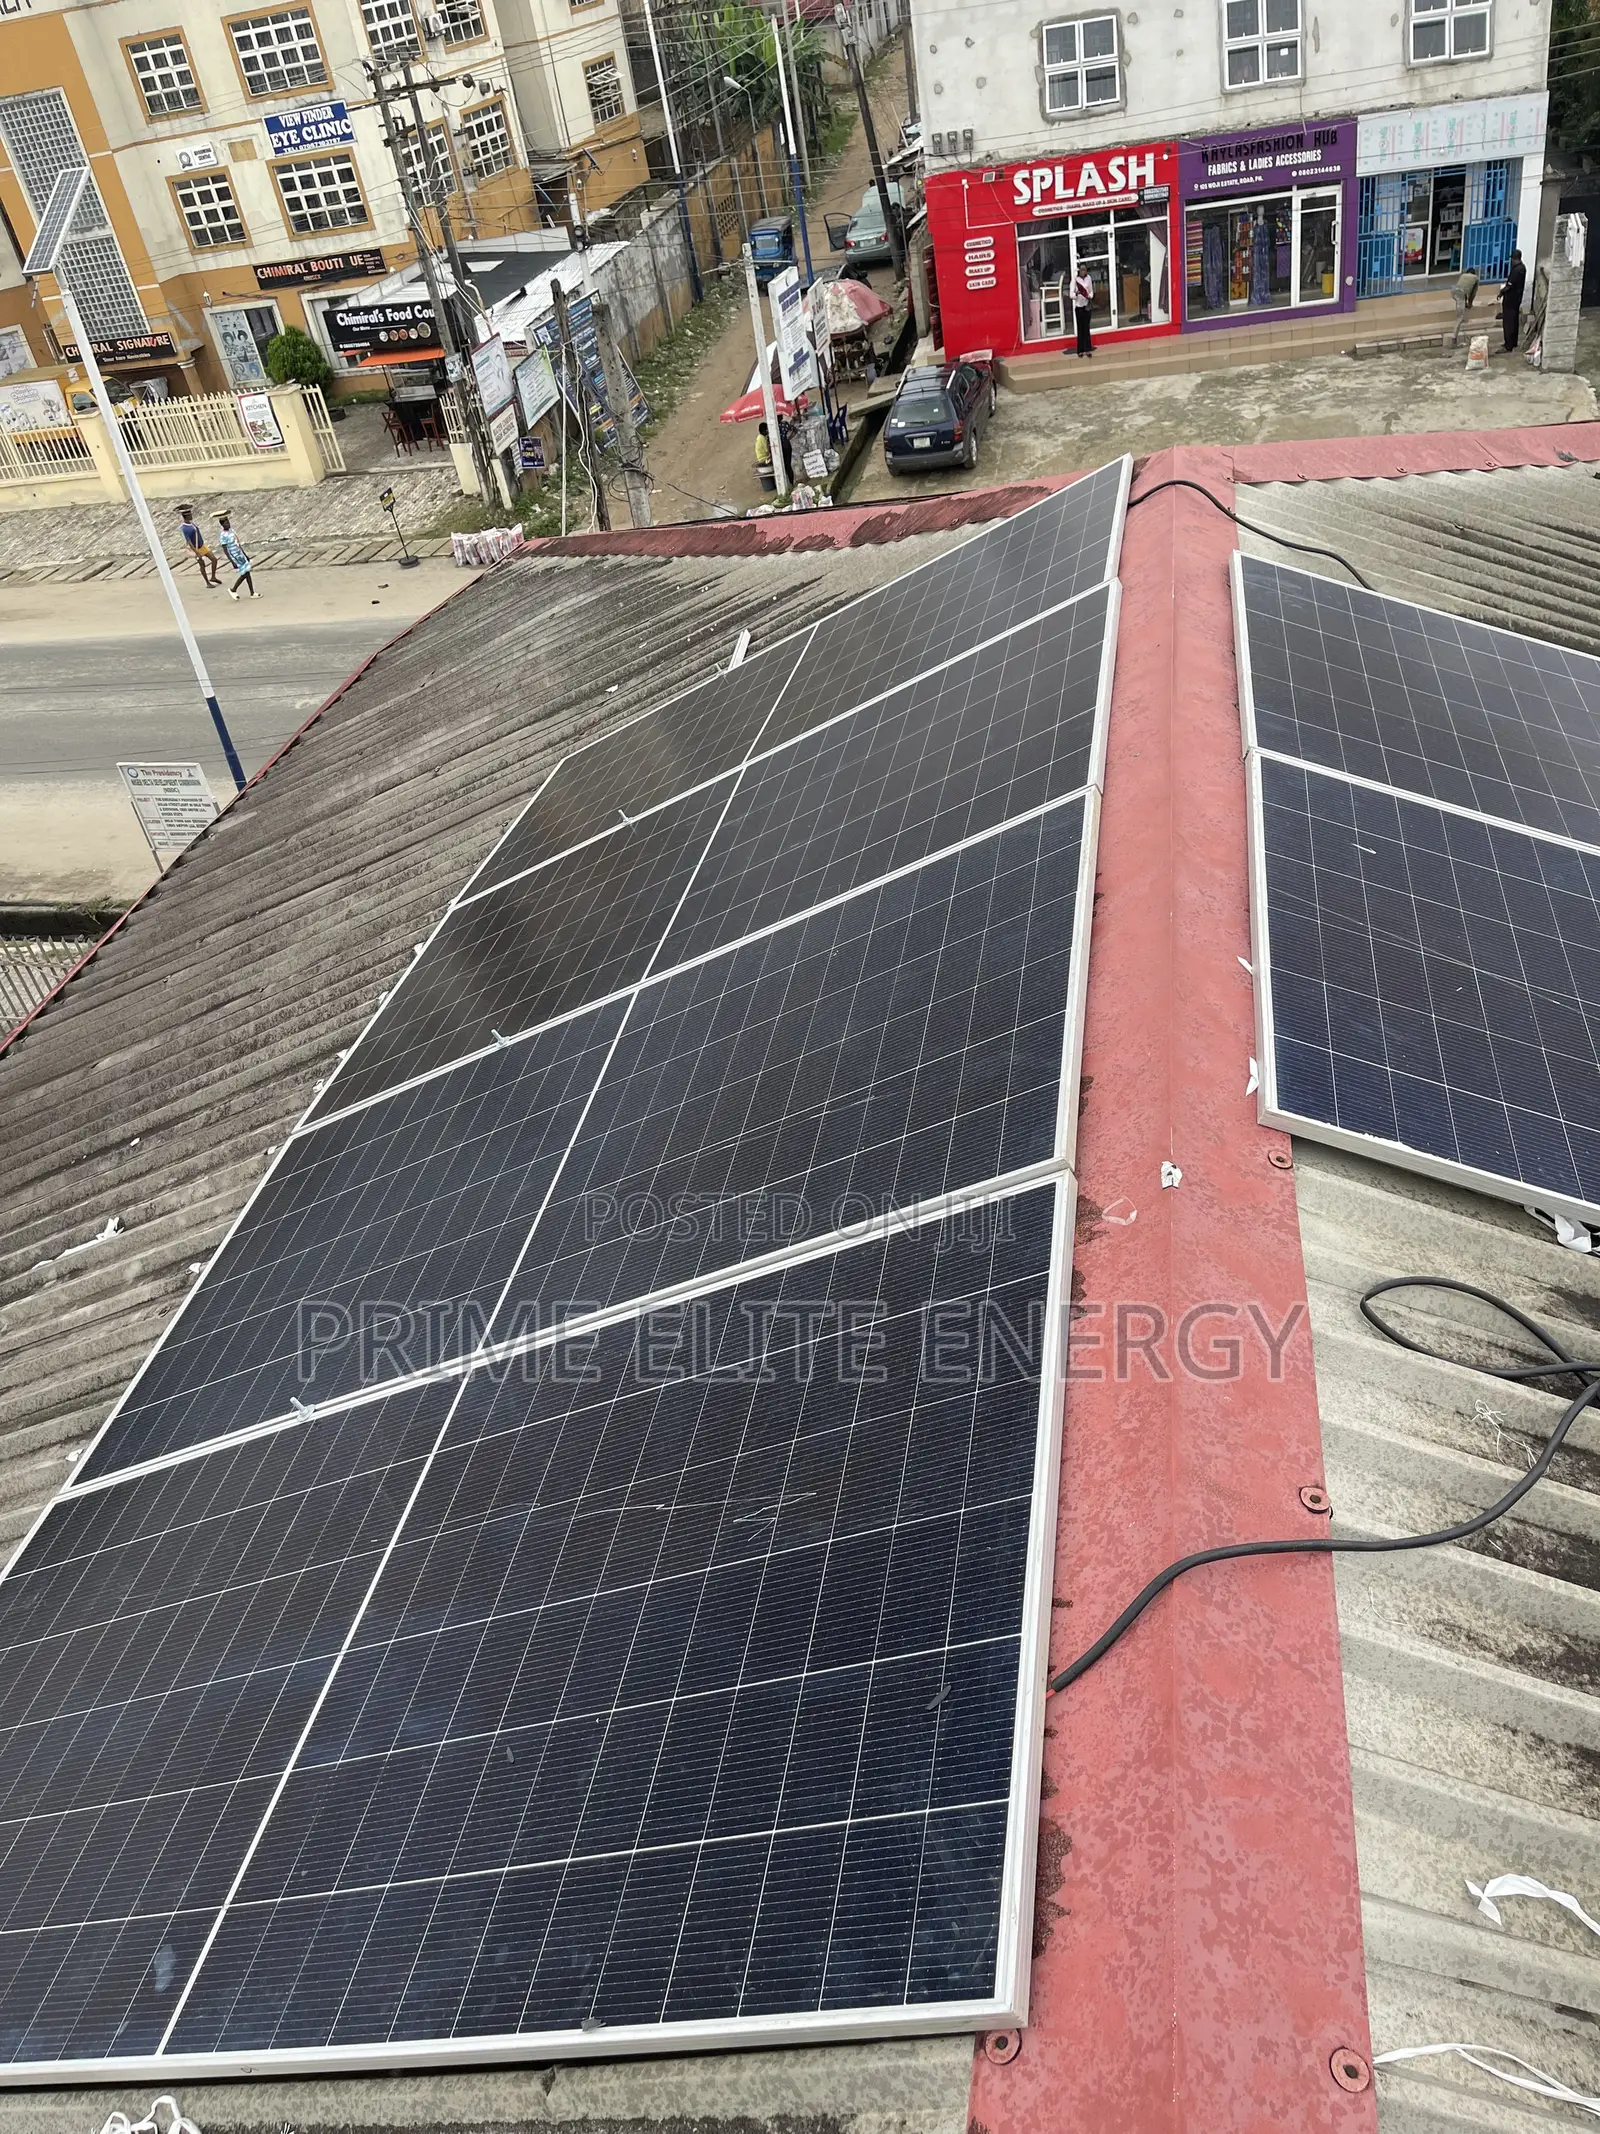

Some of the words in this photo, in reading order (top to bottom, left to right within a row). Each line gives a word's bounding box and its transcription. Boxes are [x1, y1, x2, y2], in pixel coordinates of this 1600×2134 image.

[279, 112, 301, 128] VIEW
[301, 105, 334, 124] FINDER
[270, 129, 300, 148] EYE
[302, 119, 352, 141] CLINIC
[1314, 129, 1338, 147] HUB
[1208, 161, 1238, 176] FABRICS
[1240, 161, 1246, 172] &
[1248, 157, 1273, 170] LADIES
[1276, 149, 1322, 166] ACCESSORIES
[1013, 153, 1155, 205] SPLASH
[1037, 205, 1063, 213] COSMETICS
[257, 264, 308, 279] CHIMIRAL
[336, 308, 384, 326] Chimiral's
[385, 306, 413, 321] Food
[116, 334, 170, 351] SIGNATURE
[152, 769, 182, 778] Presidency
